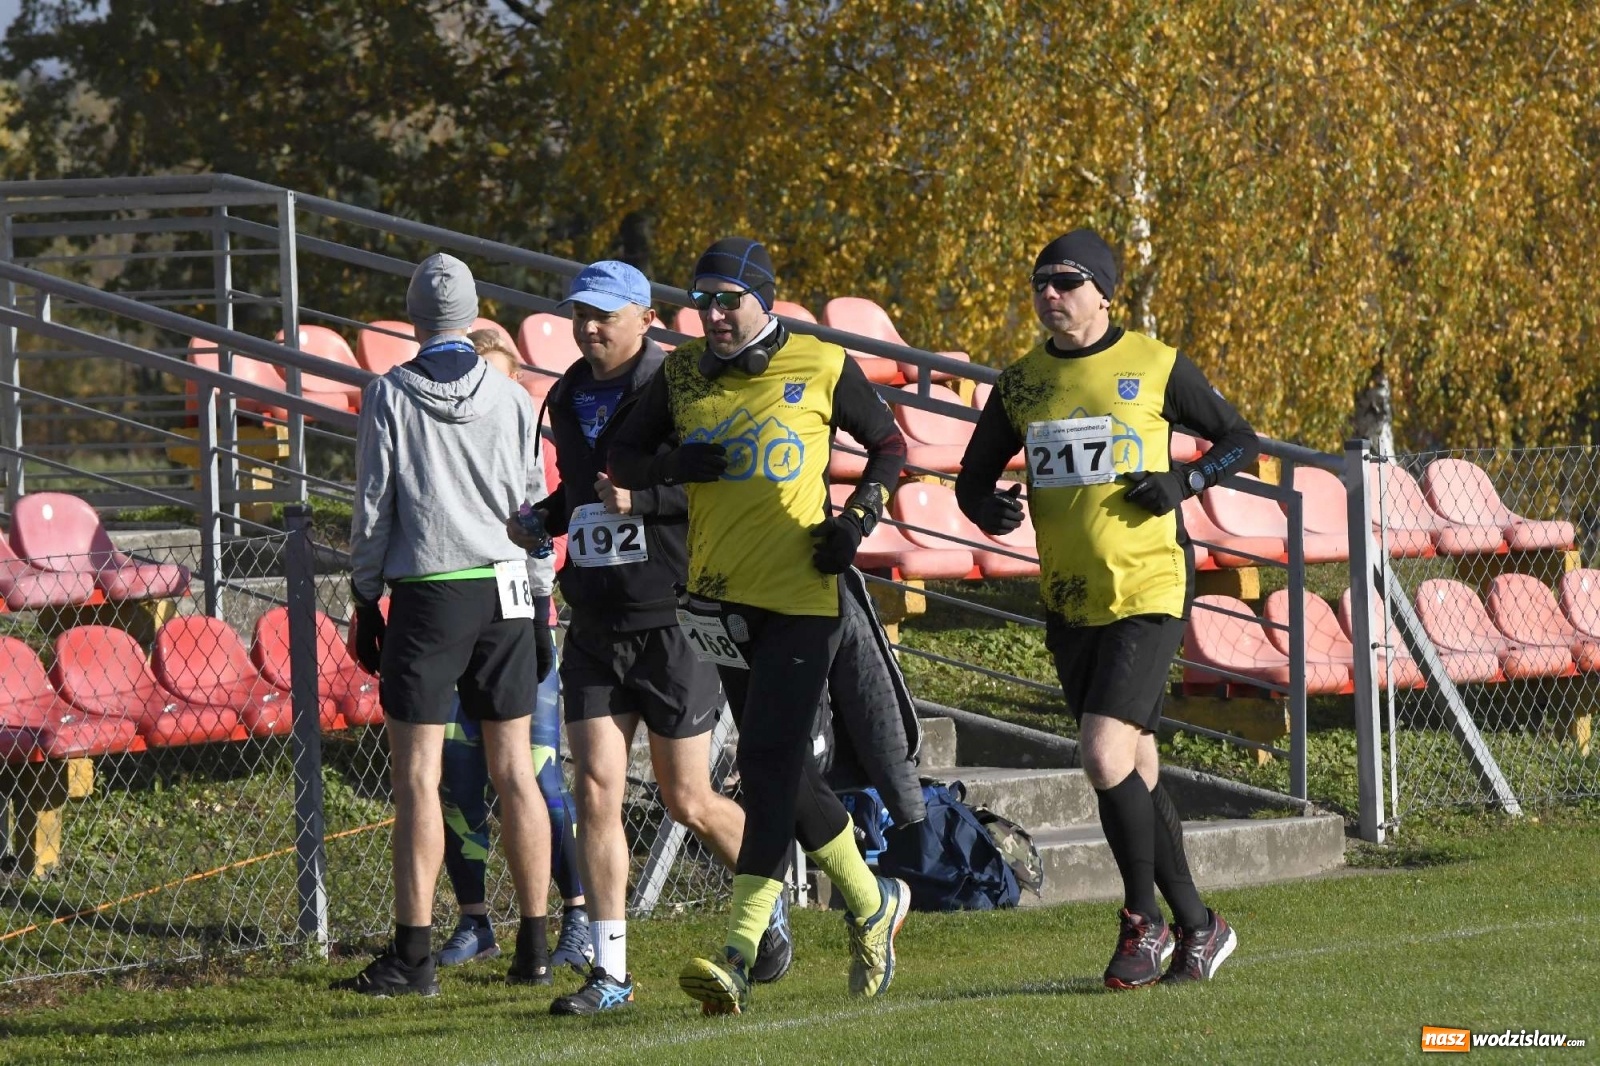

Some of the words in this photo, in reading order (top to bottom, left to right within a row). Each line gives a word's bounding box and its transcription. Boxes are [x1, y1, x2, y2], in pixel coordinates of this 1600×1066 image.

[1032, 441, 1107, 475] 217
[572, 523, 640, 556] 192
[507, 579, 534, 607] 18
[689, 628, 738, 658] 168
